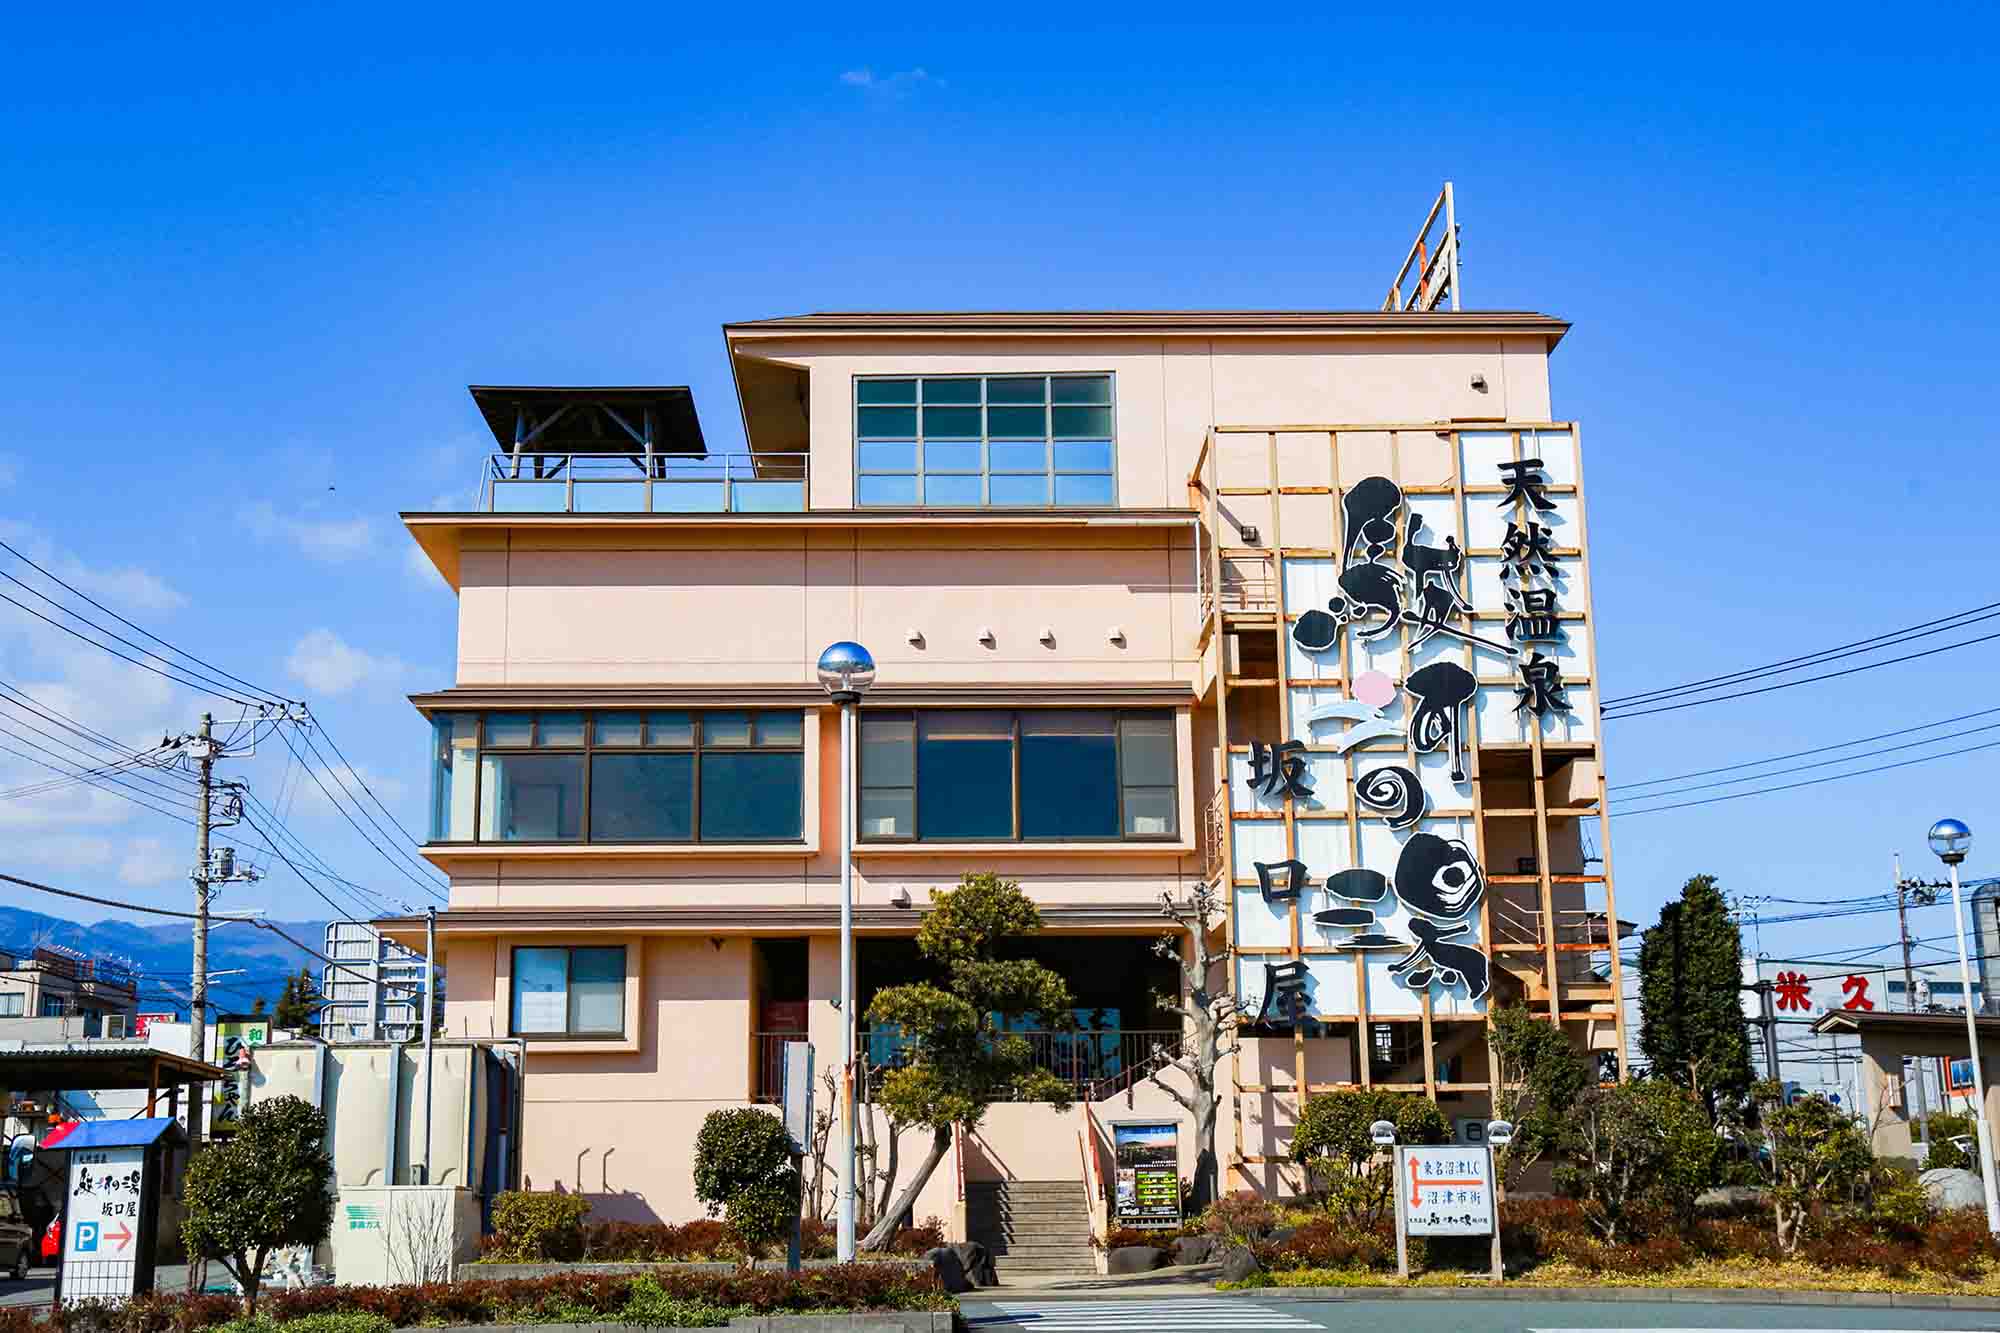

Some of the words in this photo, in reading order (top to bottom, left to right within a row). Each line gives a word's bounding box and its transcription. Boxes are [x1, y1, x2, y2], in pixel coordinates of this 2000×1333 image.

[1496, 458, 1571, 719] 天然温泉
[1247, 739, 1316, 1028] 坂口屋
[1776, 971, 1873, 1010] 米久
[102, 1201, 137, 1218] 坂口屋
[1427, 1190, 1481, 1206] 沼津市街
[79, 1225, 95, 1249] P
